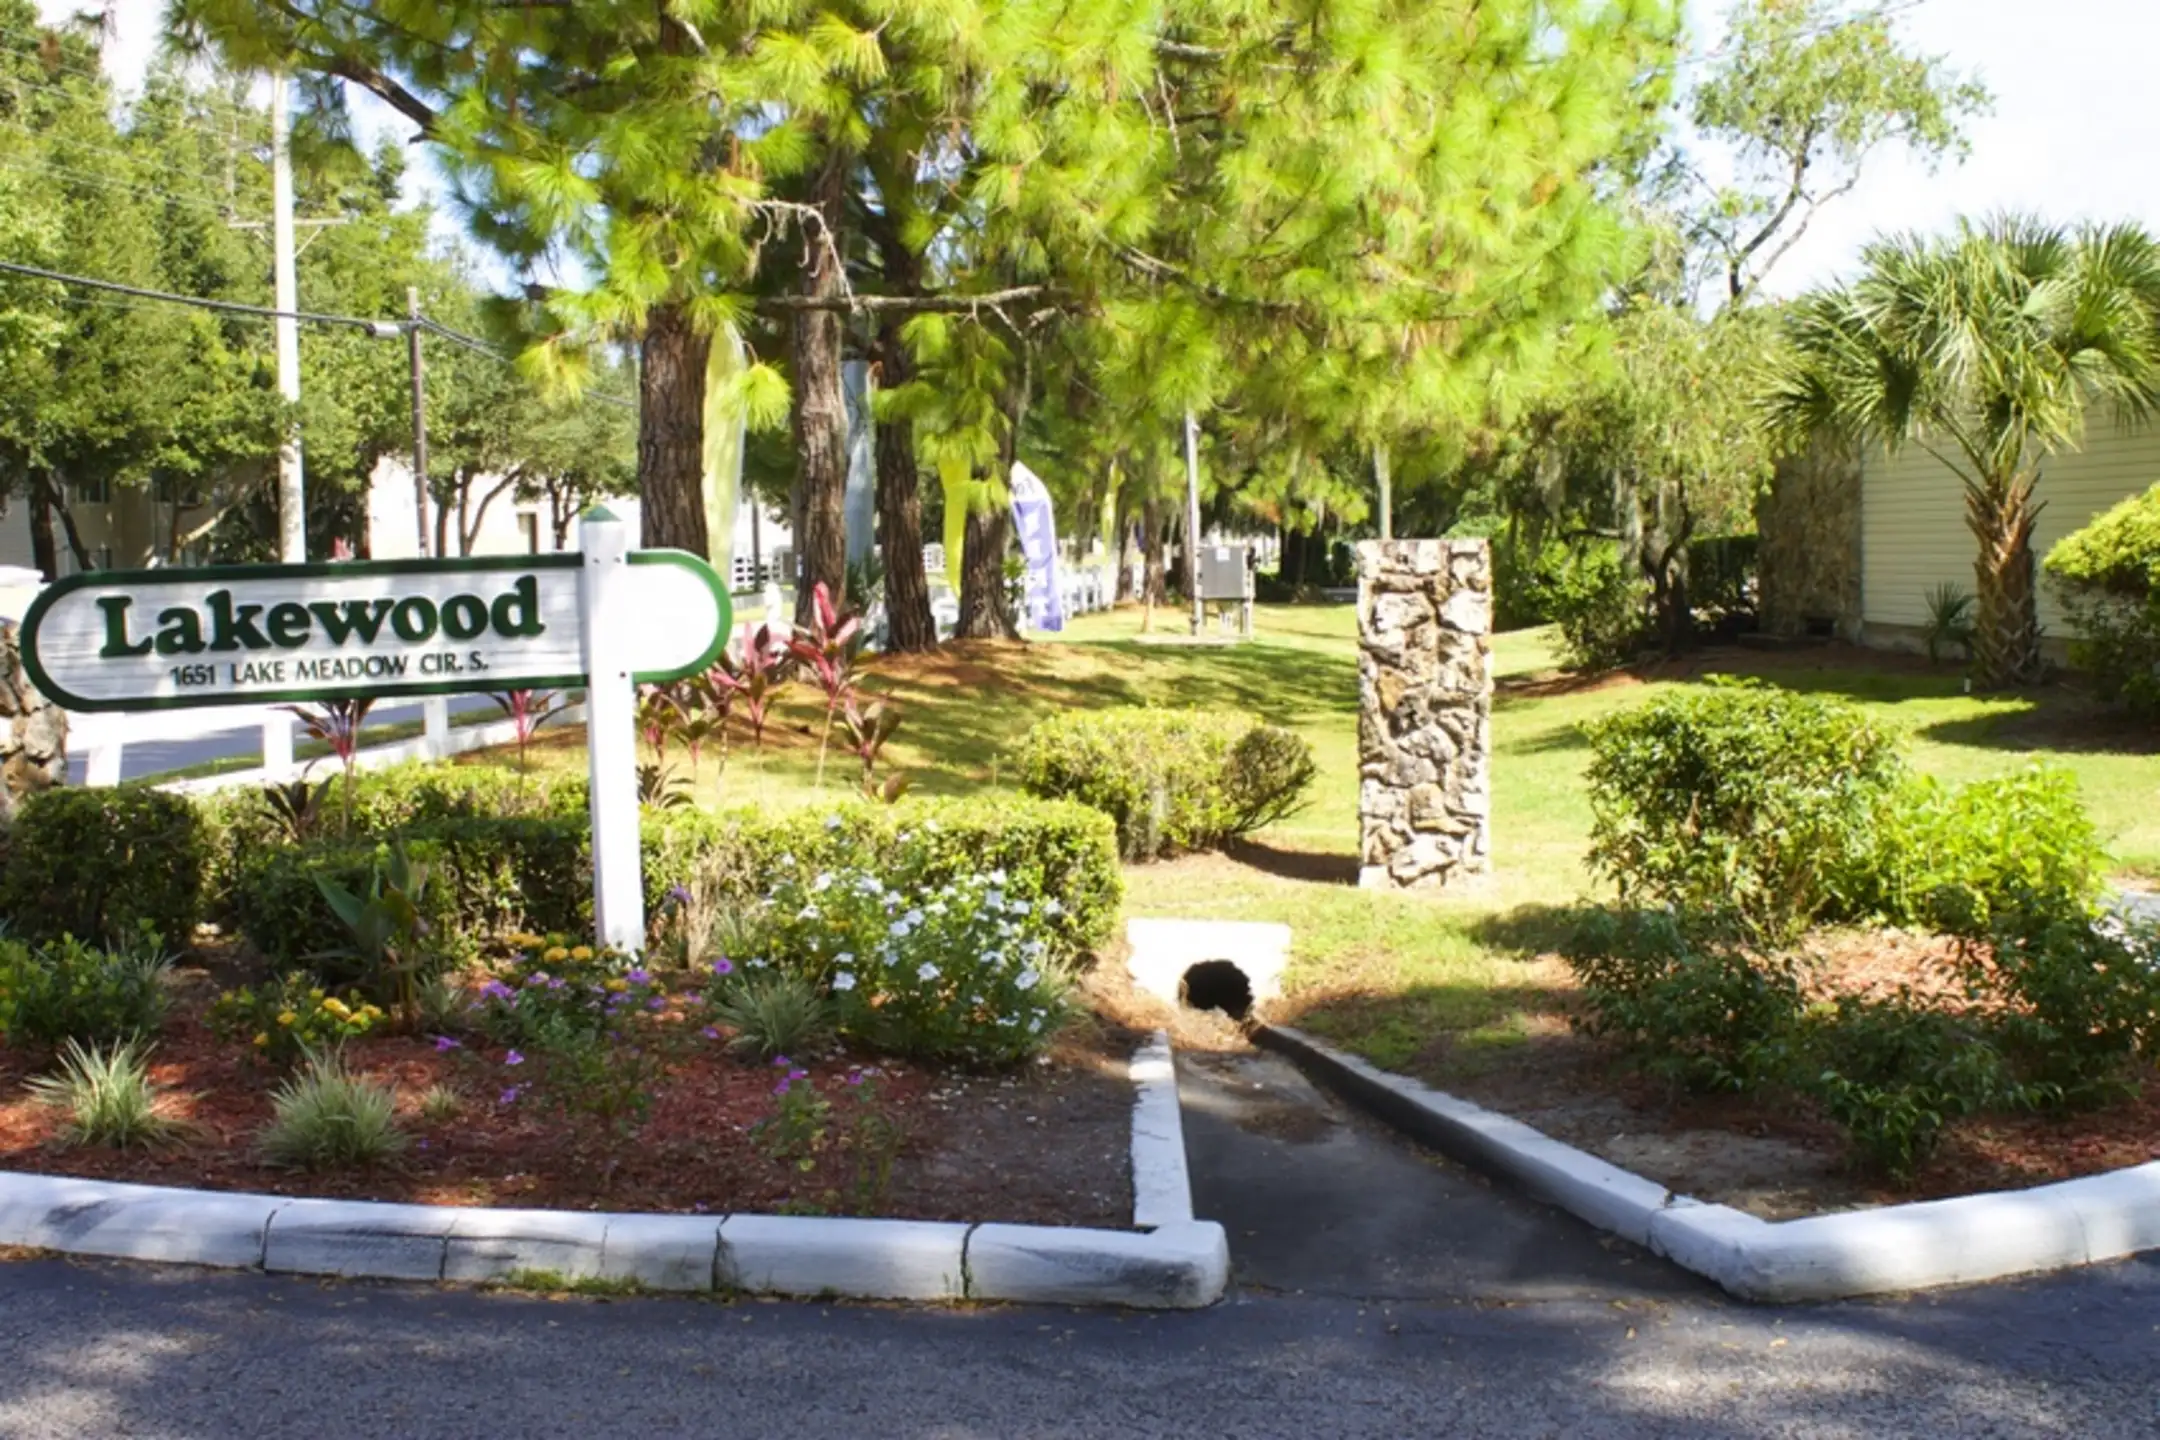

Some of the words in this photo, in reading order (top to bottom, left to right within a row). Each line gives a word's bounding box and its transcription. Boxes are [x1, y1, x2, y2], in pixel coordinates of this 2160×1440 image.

[96, 574, 546, 658] Lakewood
[171, 663, 215, 687] 1651
[231, 660, 284, 685] LAKE
[296, 655, 408, 681] MEADOW
[420, 653, 464, 674] CIR.
[469, 650, 489, 671] S.
